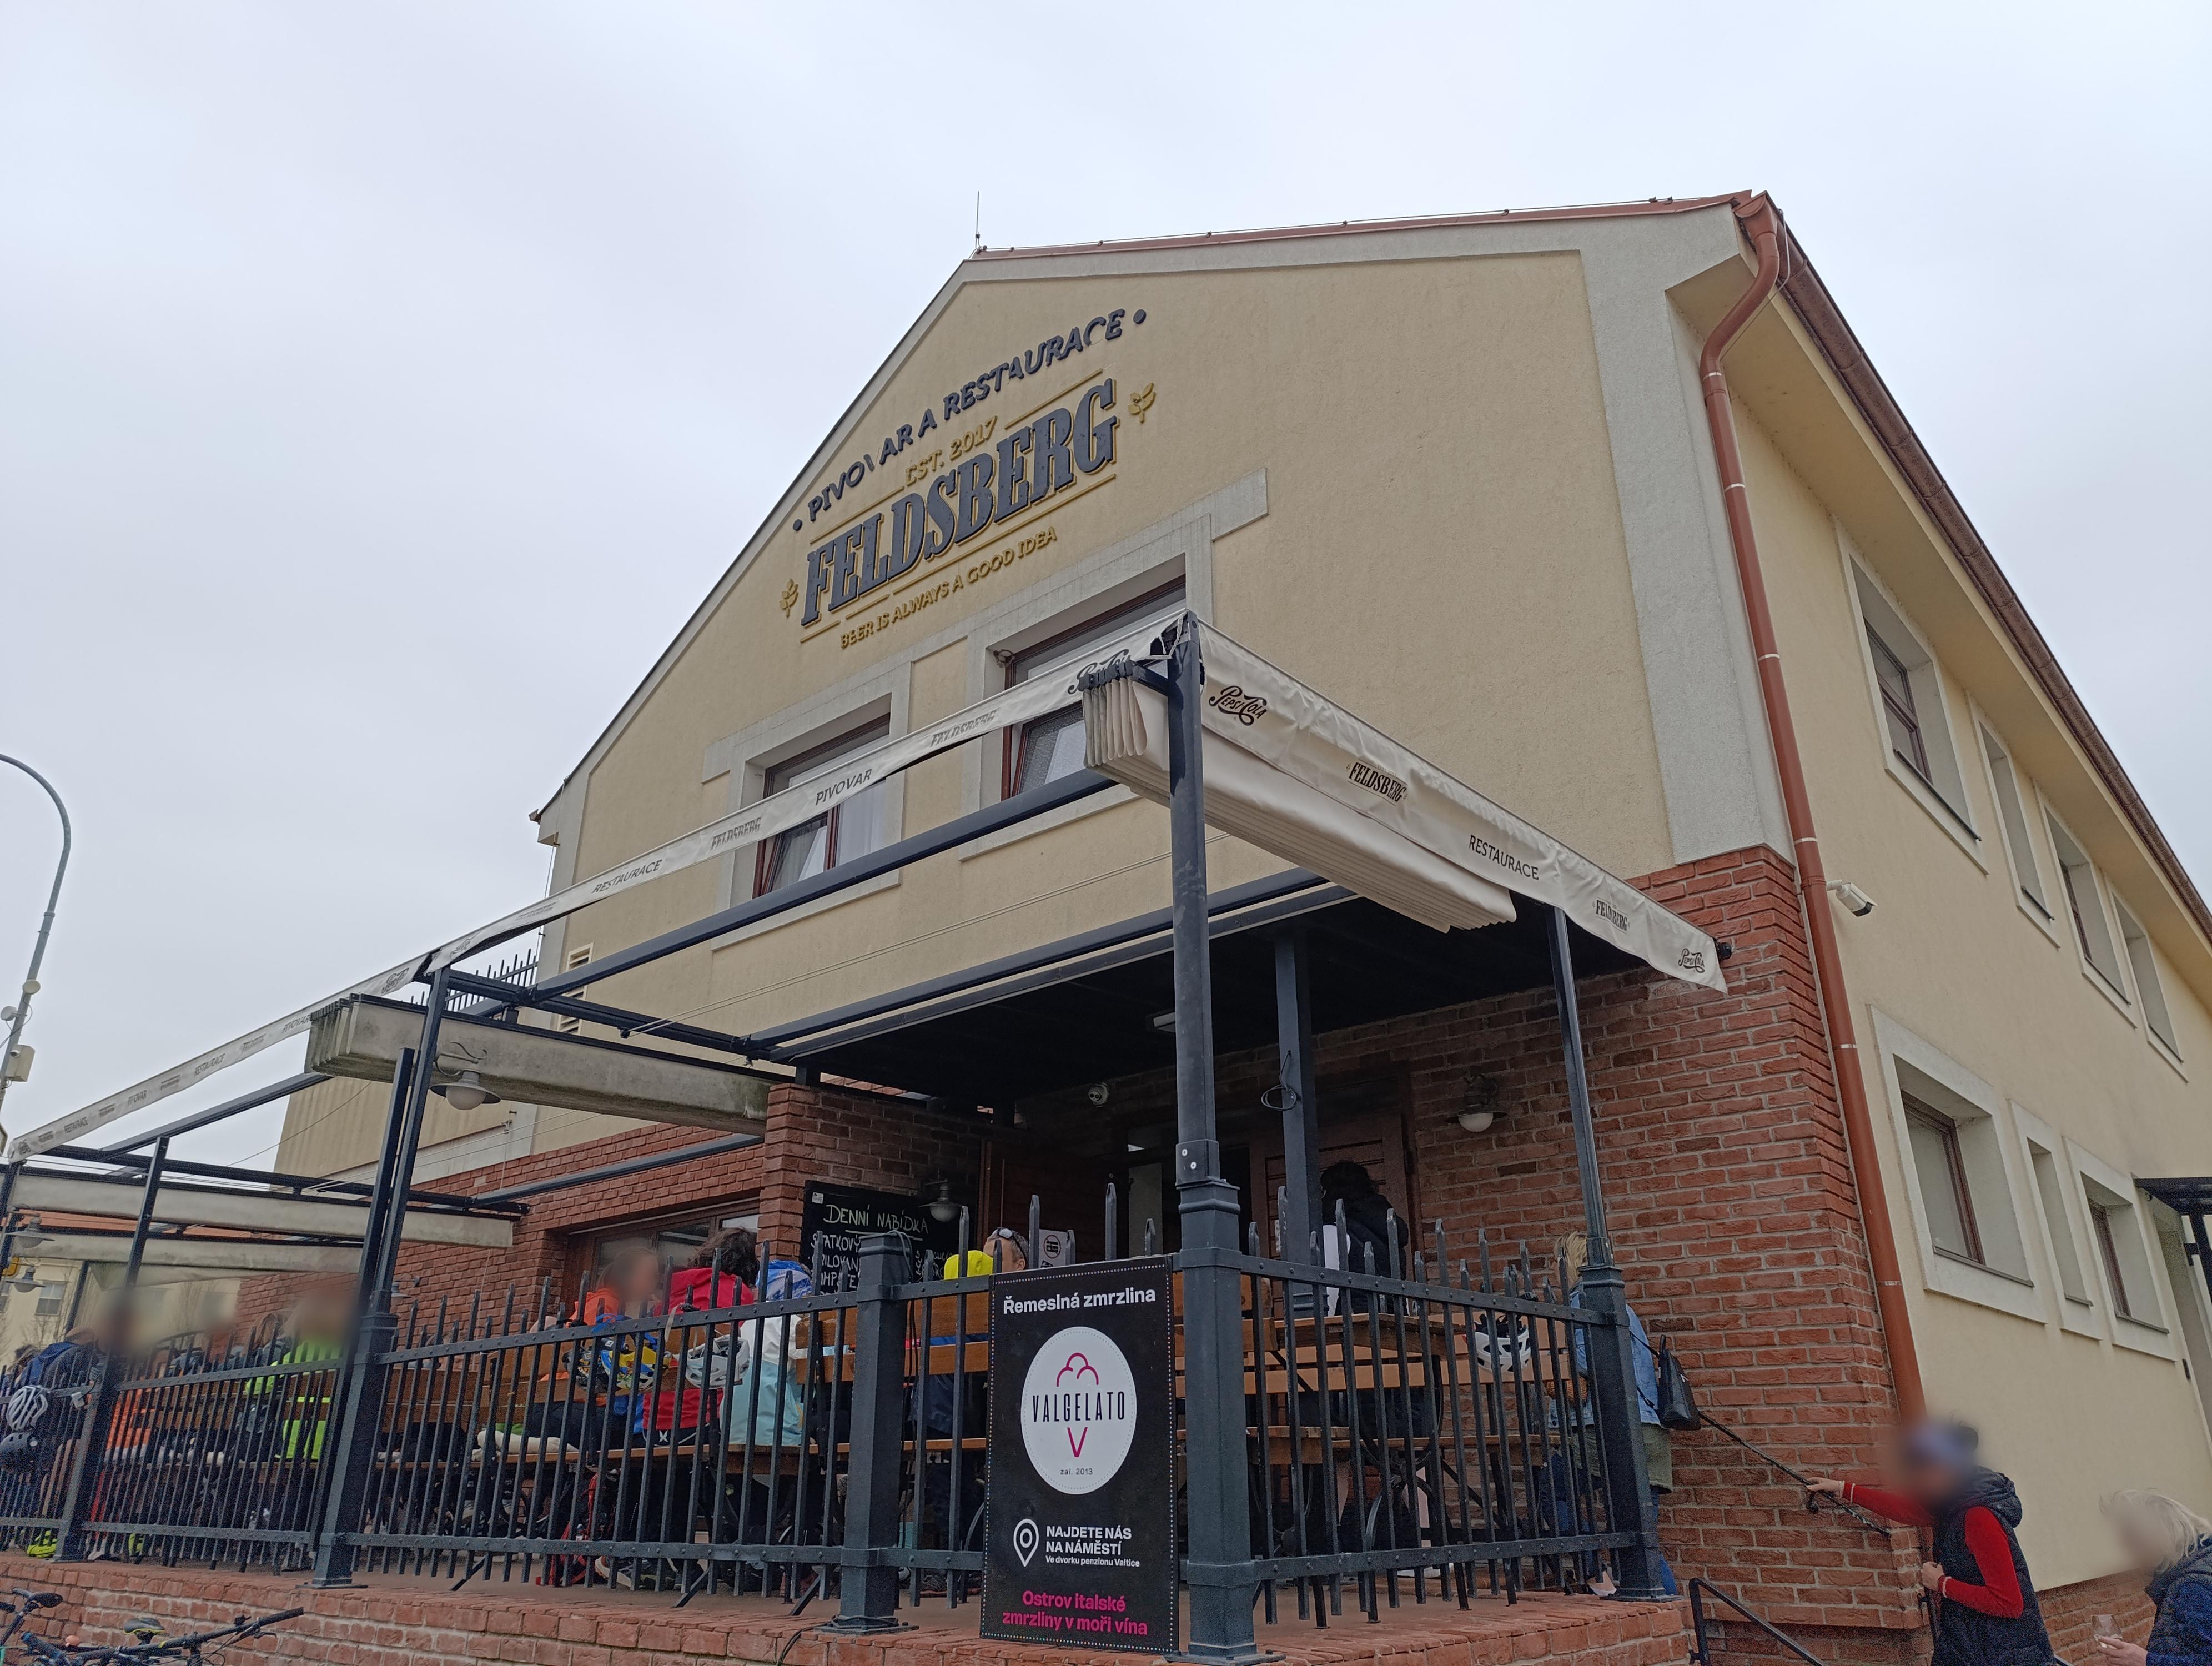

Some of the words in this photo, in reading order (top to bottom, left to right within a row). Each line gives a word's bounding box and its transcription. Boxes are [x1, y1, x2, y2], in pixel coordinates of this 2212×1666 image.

[918, 409, 937, 438] A
[943, 309, 1125, 420] RESTAURACE
[950, 415, 998, 461] 2017
[801, 378, 1120, 628] FELDSBERG
[840, 621, 873, 649] BEER
[877, 613, 889, 631] IS
[892, 581, 949, 623] ALWAYS
[952, 575, 964, 592] A
[967, 548, 1014, 583] GOOD
[1018, 526, 1057, 558] IDEA
[930, 710, 997, 747] FELDSBERG
[815, 769, 872, 805] PIVOVAR
[1349, 762, 1407, 802] FELDSBERG
[710, 817, 762, 850] FELDSBERG
[1469, 835, 1539, 880] RESTAURACE
[592, 860, 662, 893] RESTAURACE
[1596, 900, 1627, 931] FELDSBERG
[823, 1204, 870, 1226] DENNÍ
[877, 1209, 928, 1234] NABÍDKA
[1003, 1292, 1080, 1314] Řemeslná
[1083, 1287, 1155, 1307] zmrzlina
[1033, 1391, 1124, 1422] VALGELATO
[1046, 1541, 1063, 1553] NA
[1065, 1539, 1122, 1555] NÁMĚSTÍ
[1047, 1526, 1103, 1538] NAJDETE
[1105, 1525, 1132, 1539] NÁS
[1055, 1556, 1079, 1564] dvorku
[1081, 1557, 1113, 1565] penzionu
[1114, 1558, 1140, 1567] Valtice
[1022, 1590, 1072, 1609] Ostrov
[1075, 1593, 1126, 1612] italské
[1003, 1611, 1062, 1631] zmrzliny
[1065, 1617, 1074, 1629] v
[1077, 1615, 1111, 1632] moři
[1114, 1617, 1147, 1635] vína
